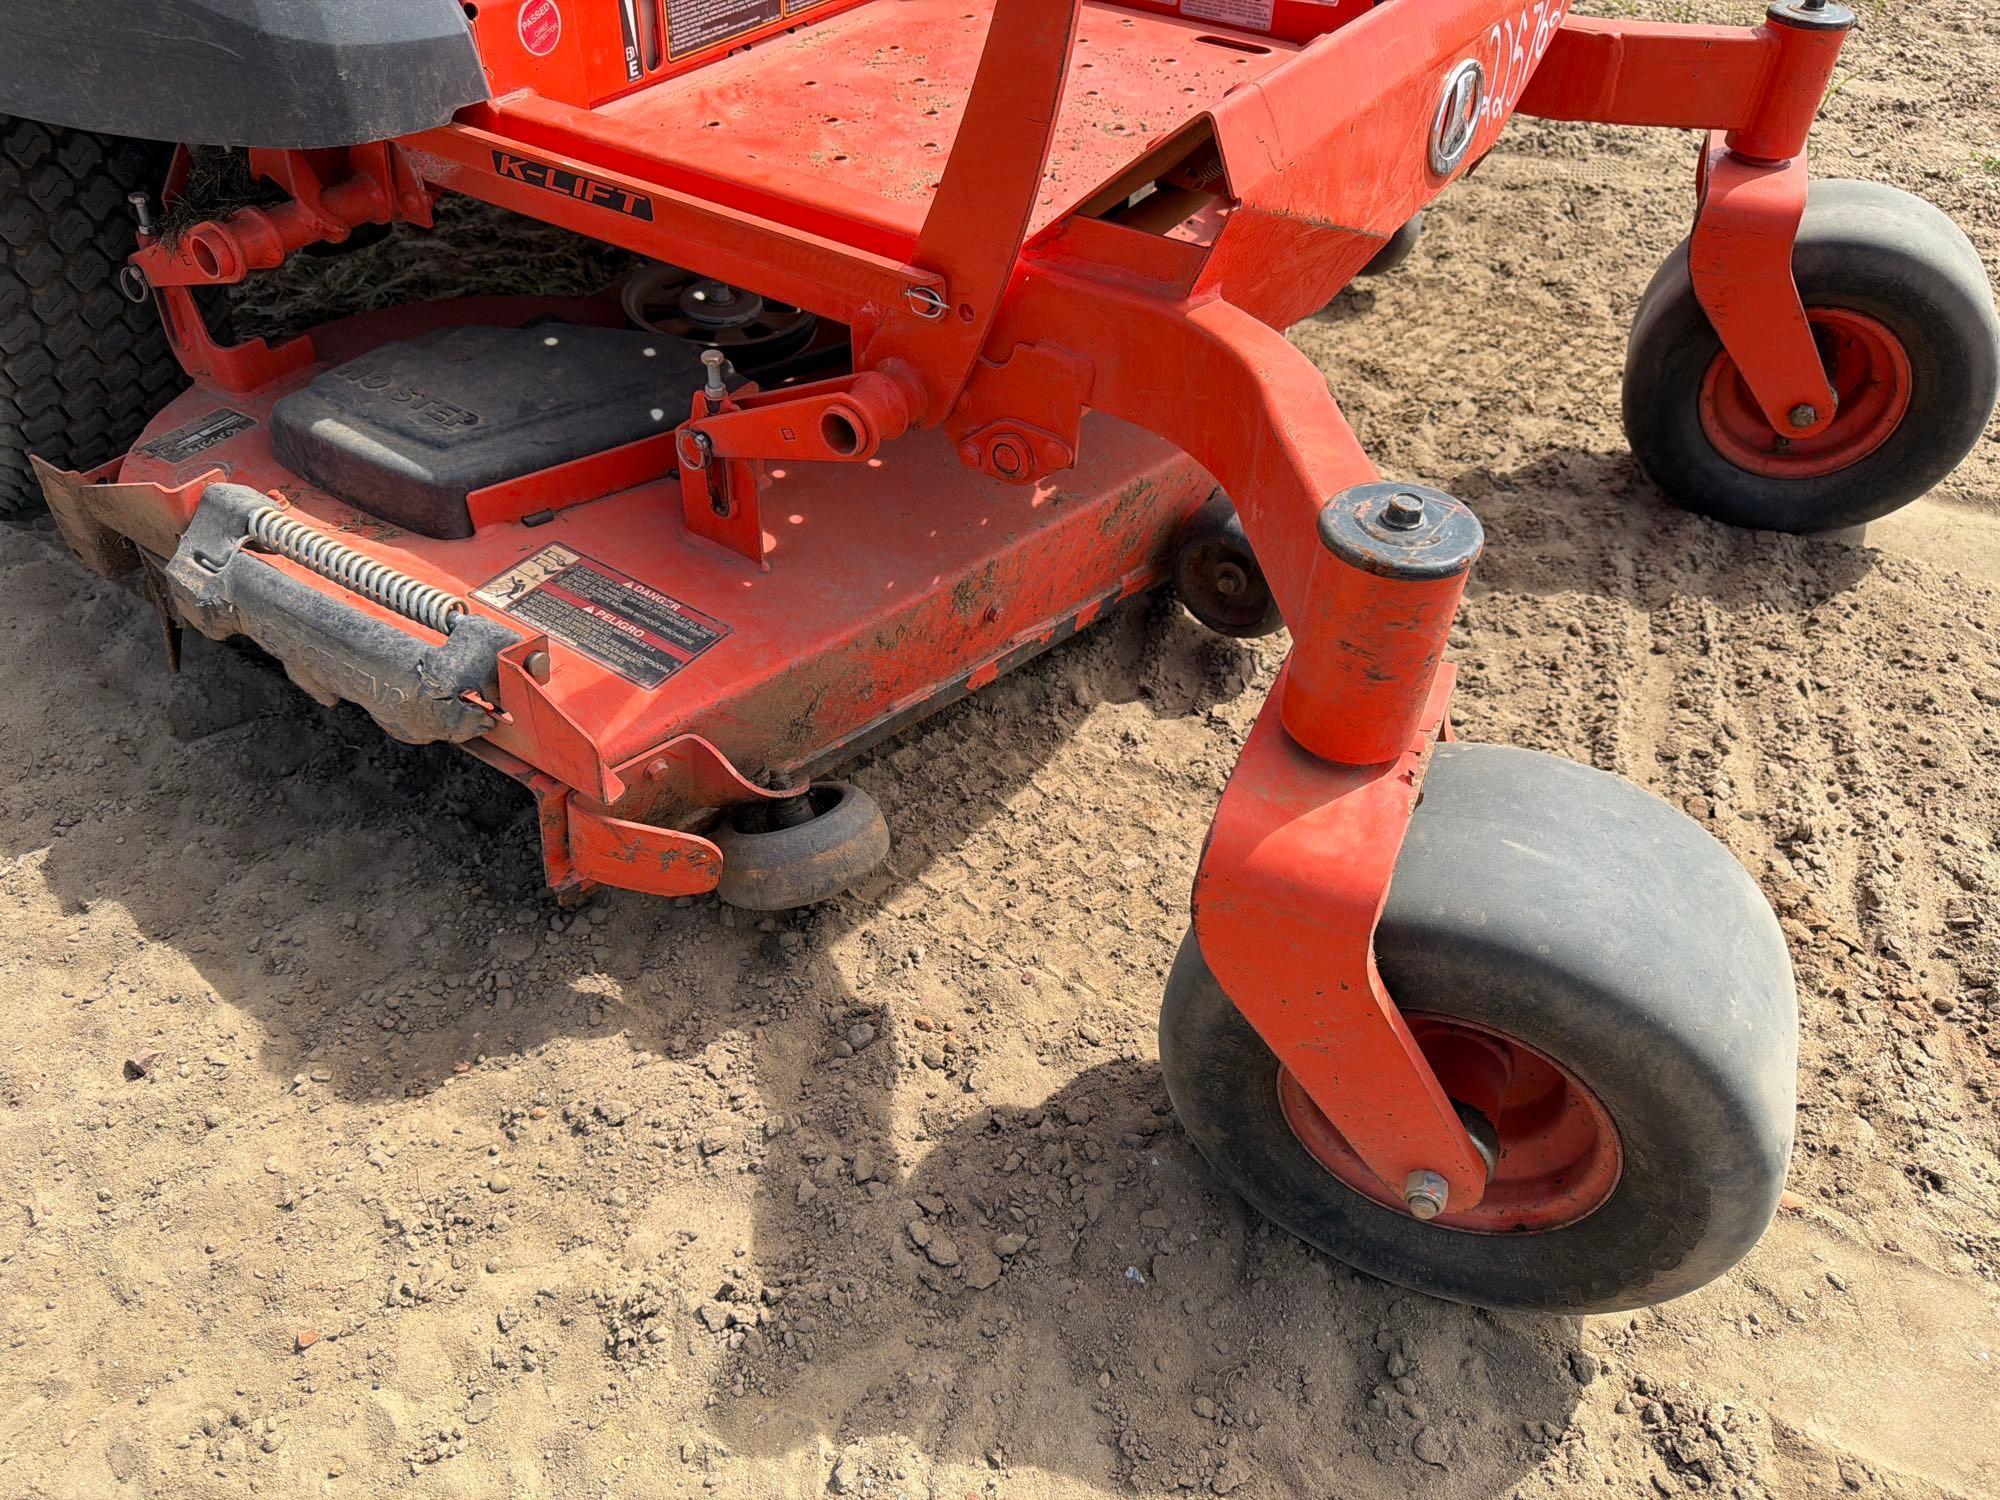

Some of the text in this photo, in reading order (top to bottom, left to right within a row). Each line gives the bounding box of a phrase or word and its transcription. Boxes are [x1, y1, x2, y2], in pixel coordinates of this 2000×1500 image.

[521, 2, 550, 31] PASSED
[628, 60, 640, 77] E
[500, 154, 646, 214] K-LIFT
[631, 584, 682, 611] DANGER
[593, 609, 646, 638] PELIGRO
